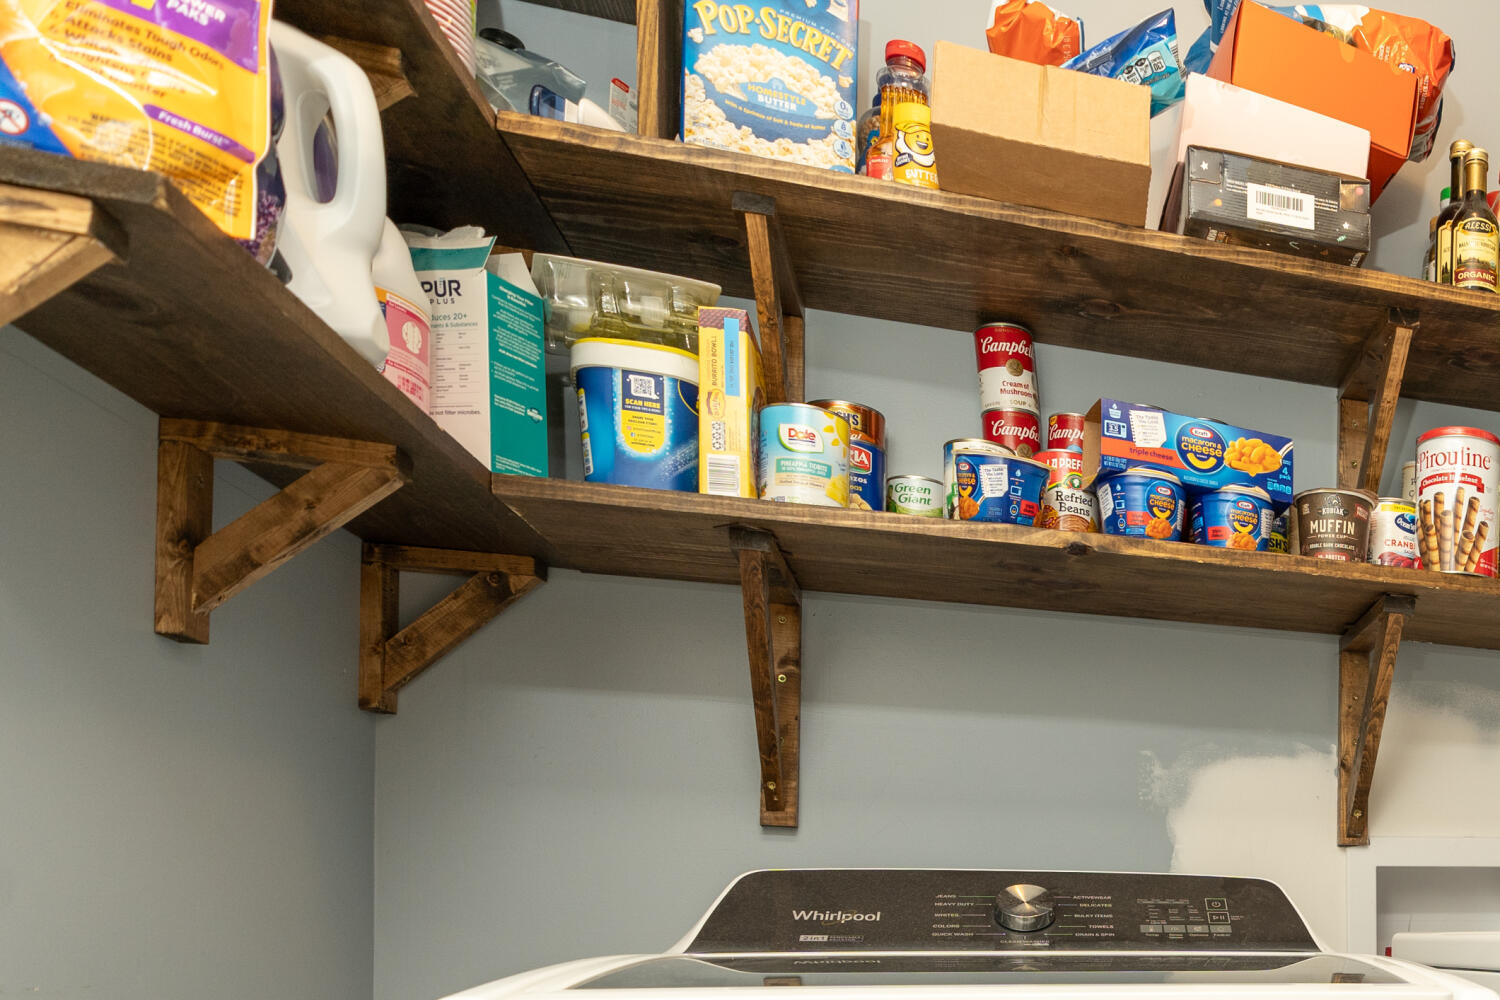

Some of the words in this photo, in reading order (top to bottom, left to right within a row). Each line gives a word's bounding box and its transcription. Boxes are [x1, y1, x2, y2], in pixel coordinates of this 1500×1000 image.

[779, 9, 817, 27] PREMIUM
[65, 16, 124, 46] Attacks
[129, 35, 173, 62] Stains
[146, 27, 187, 54] Tough
[747, 84, 807, 106] HOMESTYLE
[757, 94, 798, 112] BUTTER
[158, 110, 193, 133] Fresh
[1457, 270, 1496, 282] ORGANIC
[429, 297, 456, 306] PLUS
[1001, 379, 1021, 389] Cream
[999, 387, 1034, 400] Mushroom
[788, 427, 816, 441] Dole
[1181, 435, 1217, 449] macaroni
[1150, 450, 1174, 461] cheese
[1418, 446, 1492, 471] Pirouline
[1281, 466, 1289, 476] 4
[1422, 474, 1449, 488] Chocolate
[894, 482, 932, 496] Green
[898, 492, 933, 507] Giant
[1055, 490, 1094, 508] Refried
[1058, 502, 1091, 517] Beans
[1309, 518, 1356, 536] MUFFIN
[792, 909, 881, 924] Whirlpool
